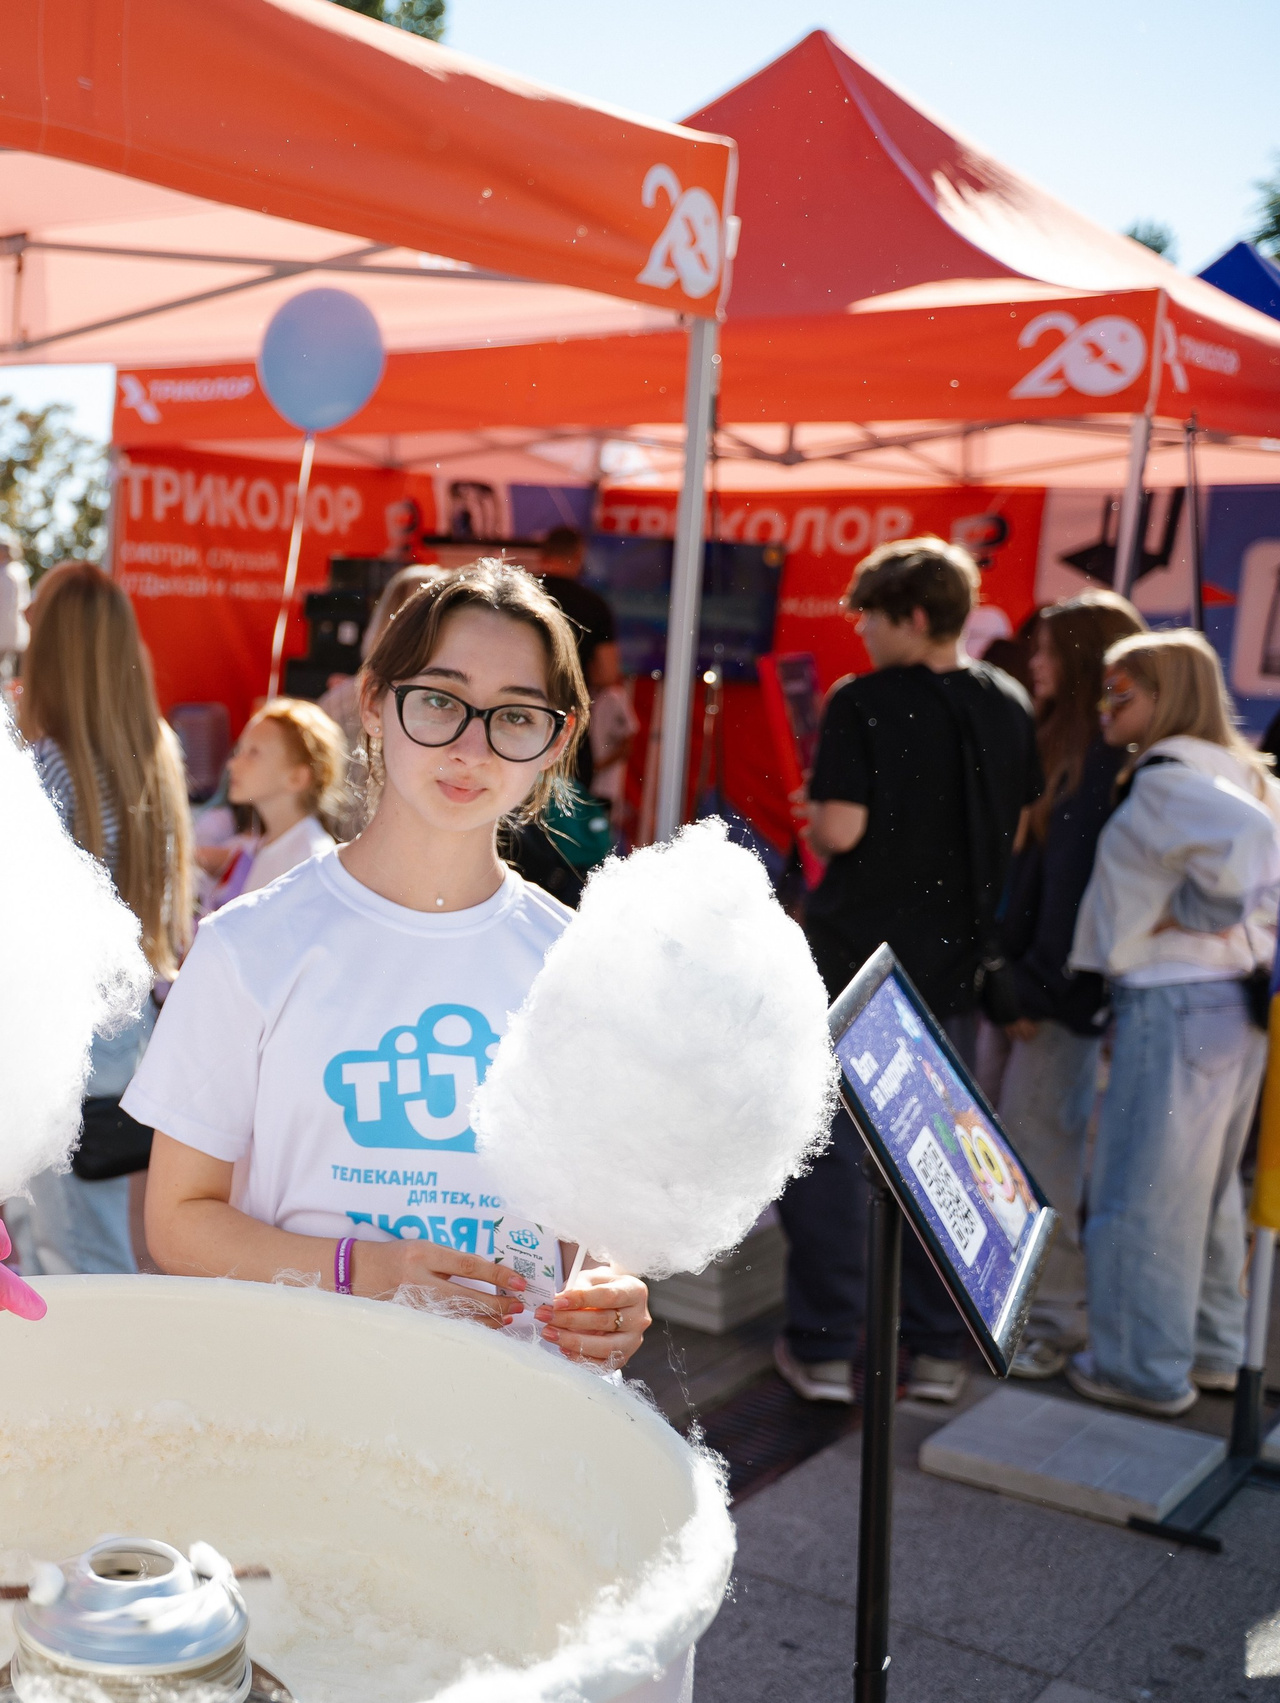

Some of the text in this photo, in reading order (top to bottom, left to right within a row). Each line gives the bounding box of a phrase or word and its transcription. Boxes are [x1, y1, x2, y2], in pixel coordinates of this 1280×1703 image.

[125, 463, 363, 535] ТРИКОЛОР
[331, 1164, 437, 1186] ТЕЛЕКАНАЛ
[407, 1189, 437, 1206] ДЛЯ
[441, 1190, 475, 1209] ТЕХ,
